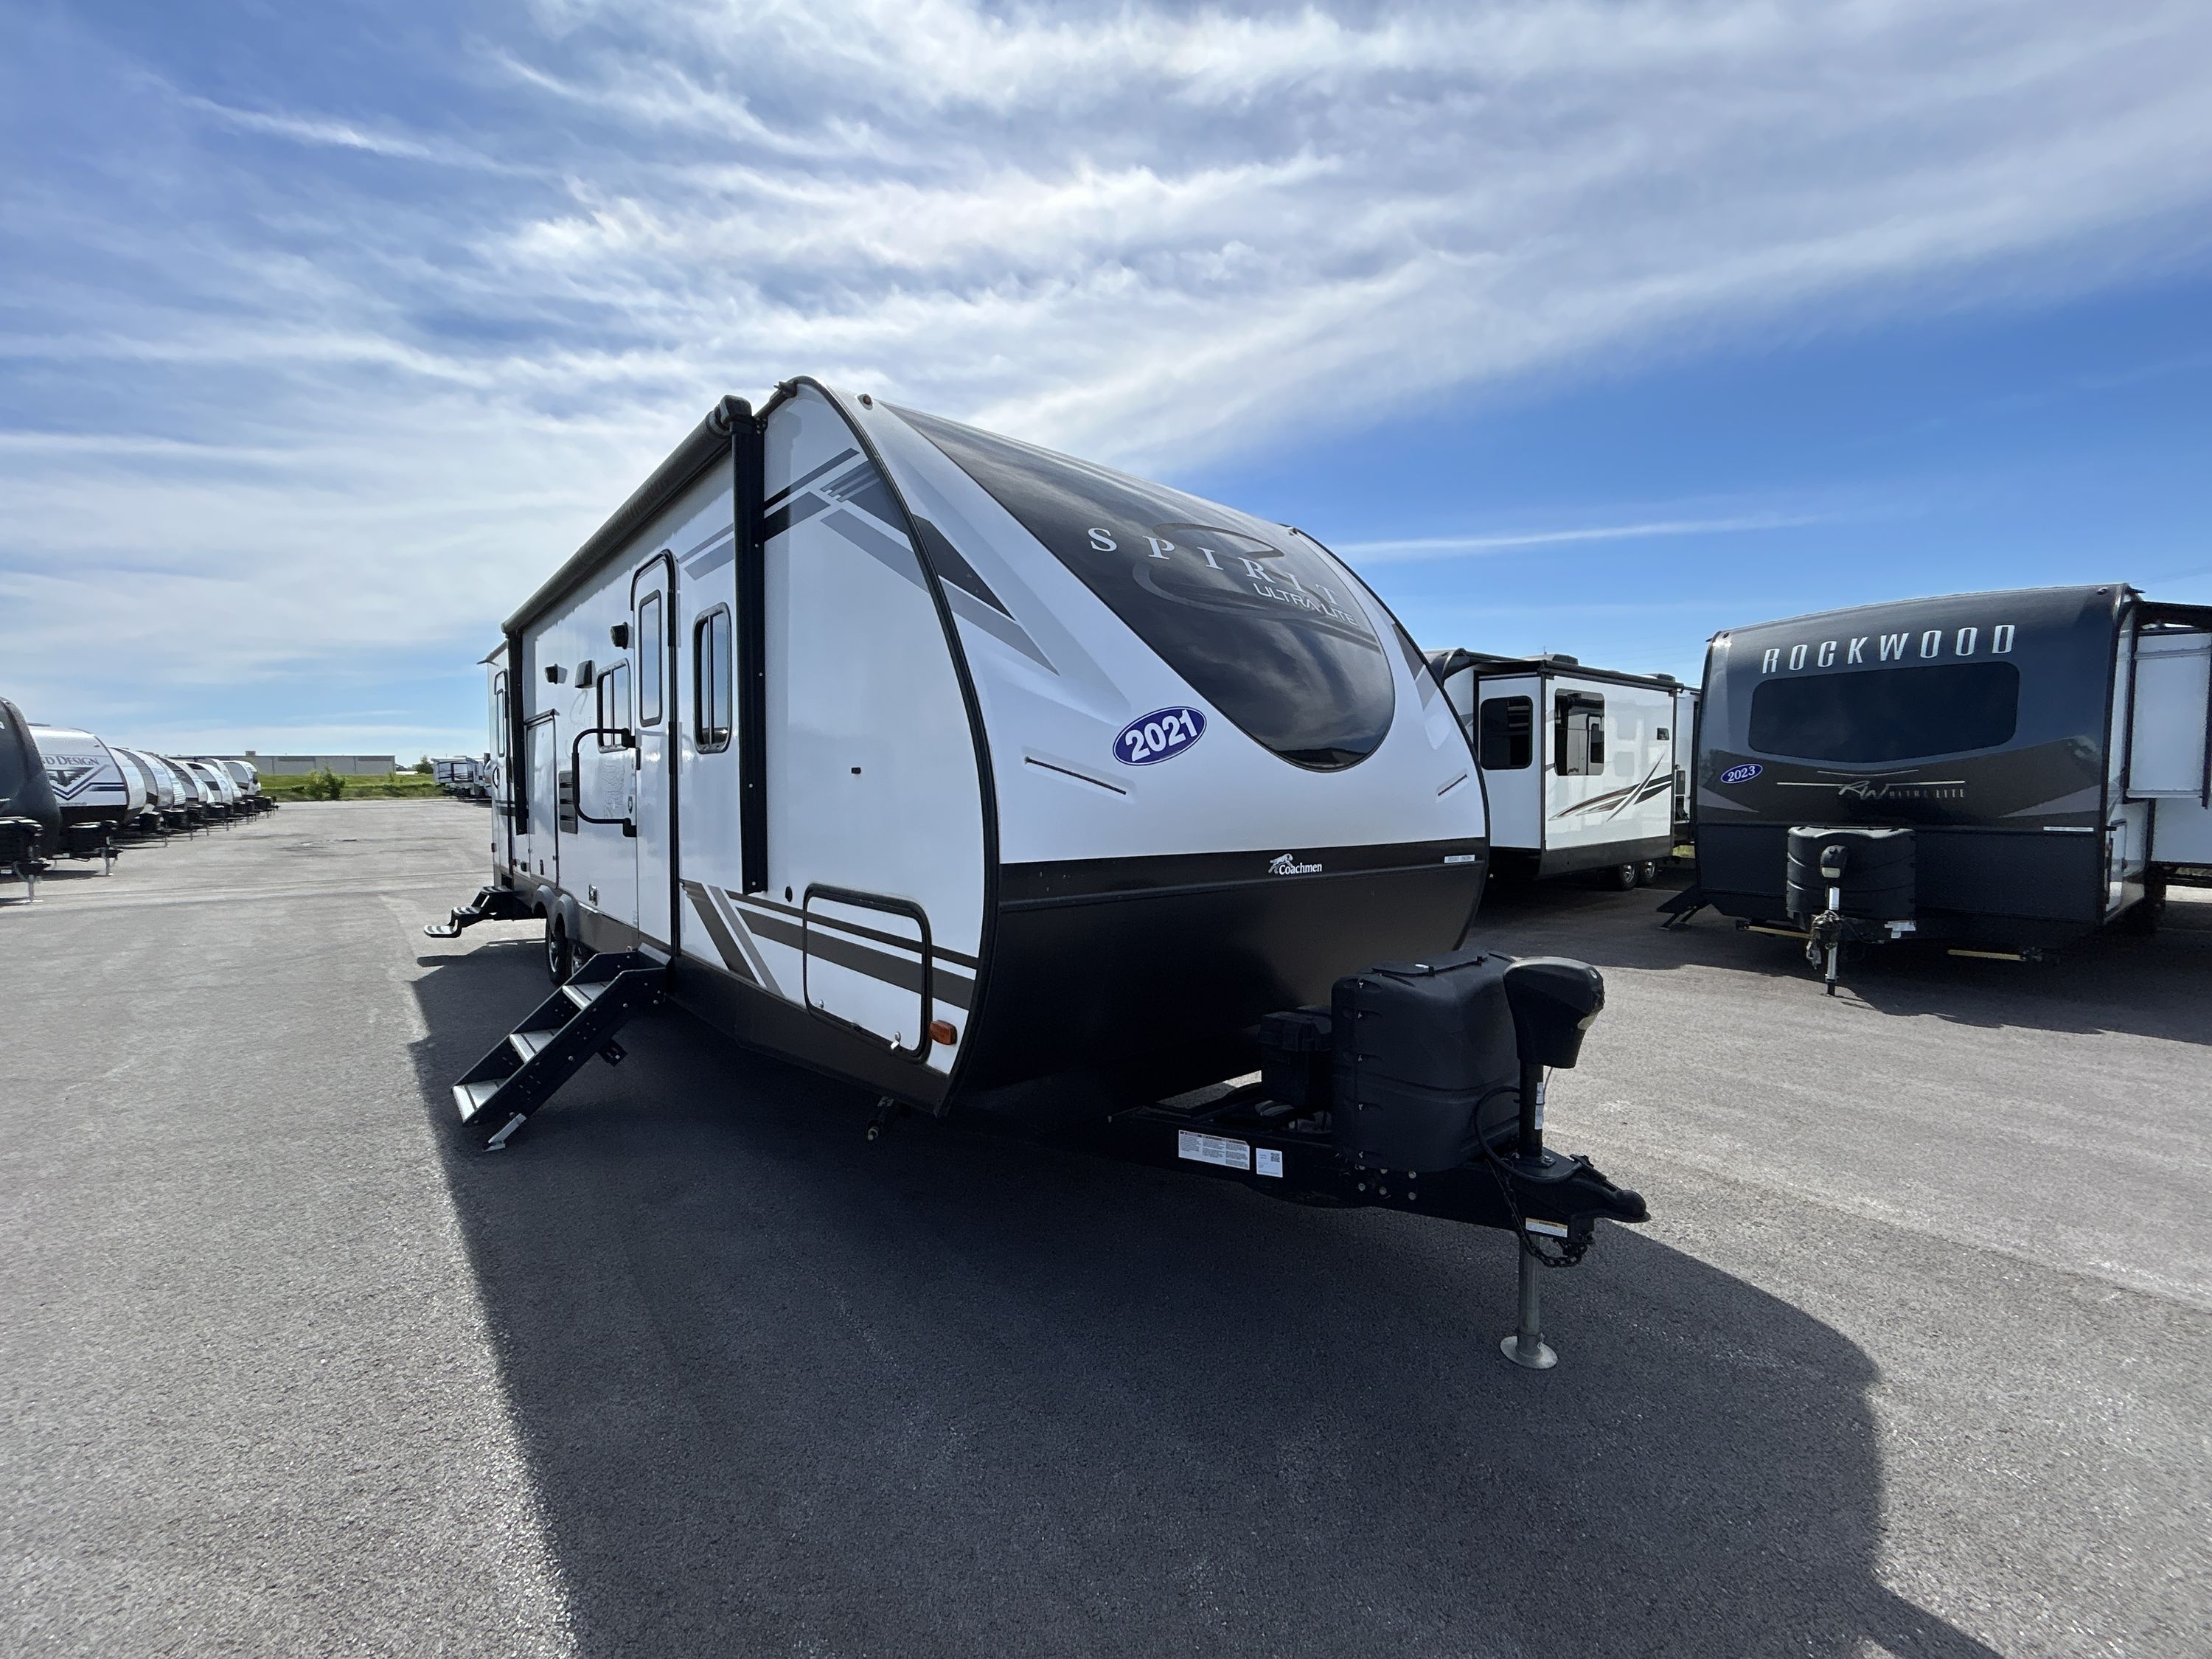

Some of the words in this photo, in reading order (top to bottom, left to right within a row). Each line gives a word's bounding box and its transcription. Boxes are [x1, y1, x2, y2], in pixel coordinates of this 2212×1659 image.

[1088, 527, 1340, 606] SPIRIT
[1253, 582, 1324, 615] ULTRA
[1321, 603, 1358, 627] LITE
[1761, 625, 2016, 675] ROCKWOOD
[1124, 709, 1198, 762] 2021
[56, 756, 100, 766] DESIGN
[1728, 765, 1756, 782] 2023
[1279, 862, 1323, 875] Coachmen
